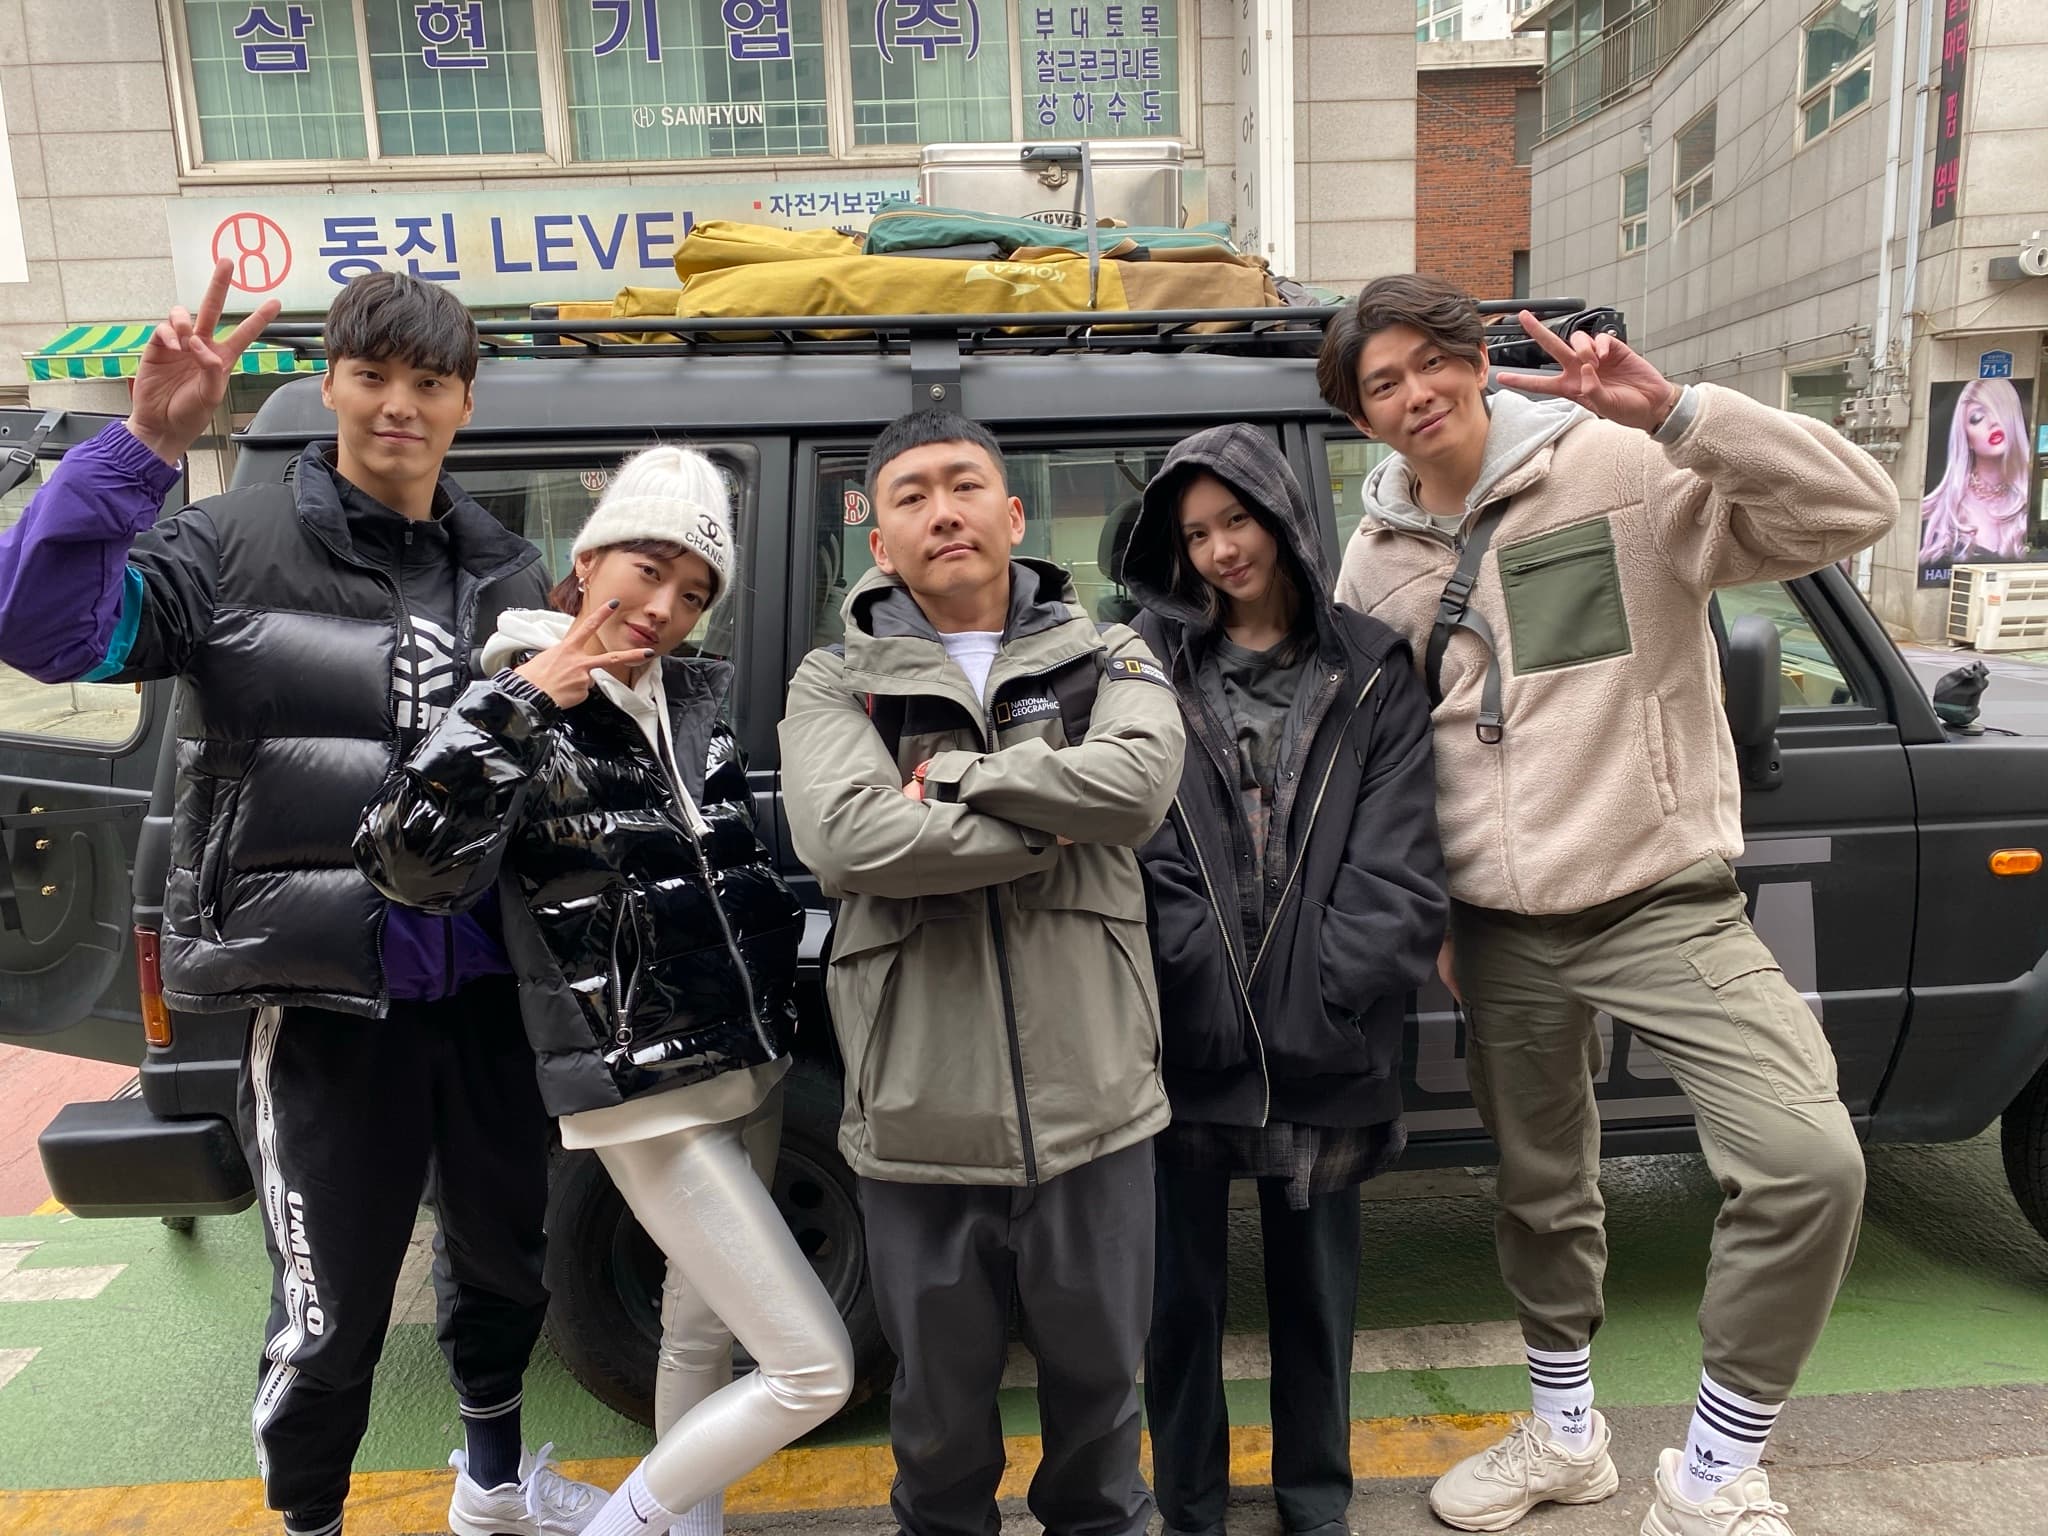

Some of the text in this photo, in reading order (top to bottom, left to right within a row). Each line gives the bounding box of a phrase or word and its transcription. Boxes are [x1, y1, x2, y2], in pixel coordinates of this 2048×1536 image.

[1036, 47, 1161, 83] 철근콘크리트
[1241, 0, 1254, 209] 이야기
[661, 105, 764, 127] SAMHYUN
[318, 213, 461, 285] 동진
[1983, 364, 2008, 377] 71-1
[1010, 697, 1048, 709] NATIONAL
[1011, 700, 1060, 717] GEOGRAPHIC
